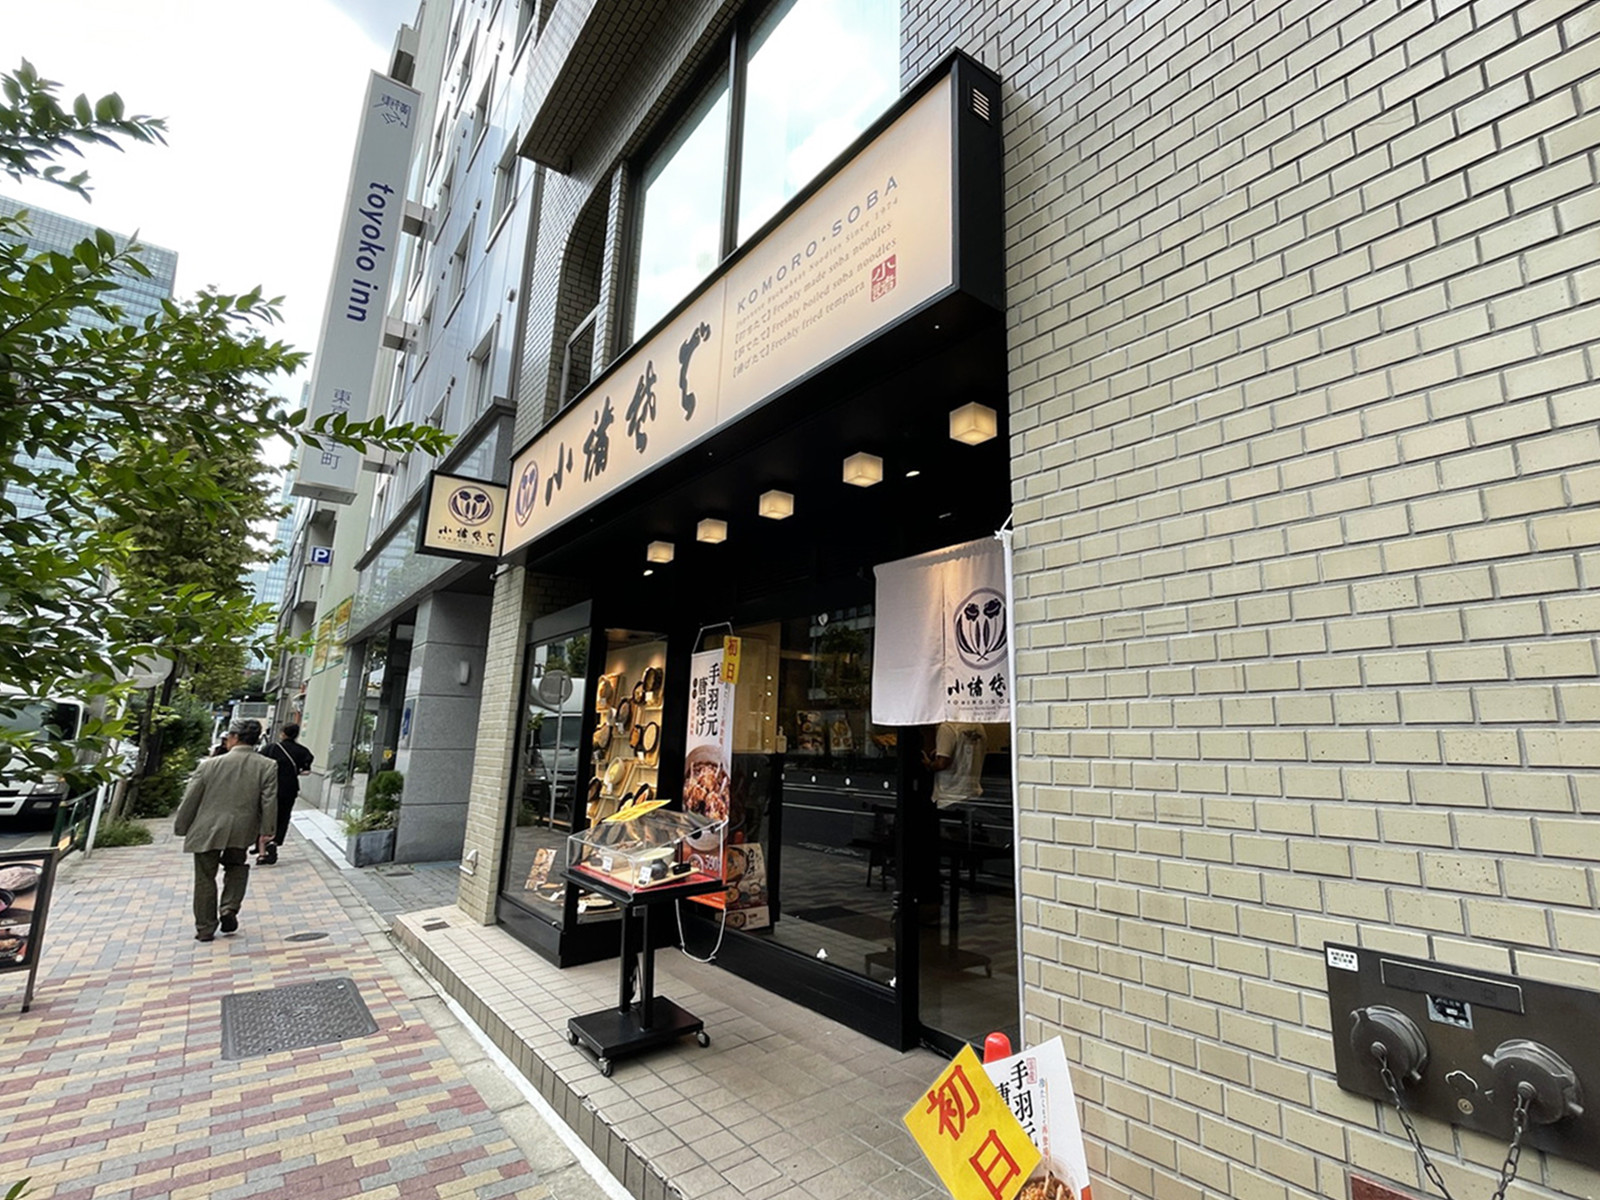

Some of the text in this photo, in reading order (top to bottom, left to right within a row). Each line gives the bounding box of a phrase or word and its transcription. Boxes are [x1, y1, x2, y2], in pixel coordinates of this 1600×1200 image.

[347, 181, 395, 323] toyoko inn
[773, 290, 801, 315] Freshly
[804, 269, 827, 292] made
[828, 253, 850, 273] soba
[852, 220, 892, 256] noodles
[845, 220, 870, 243] Since
[771, 325, 801, 352] Freshly
[802, 308, 824, 331] fried
[826, 280, 865, 314] tempura
[772, 307, 801, 333] Freshly
[803, 284, 831, 312] boiled
[832, 268, 854, 290] soba
[856, 237, 897, 272] noodles
[314, 549, 328, 562] P
[726, 638, 738, 681] 初日
[695, 676, 708, 737] 唐揚げ
[705, 662, 721, 737] 手羽元
[926, 1064, 1021, 1200] 初日
